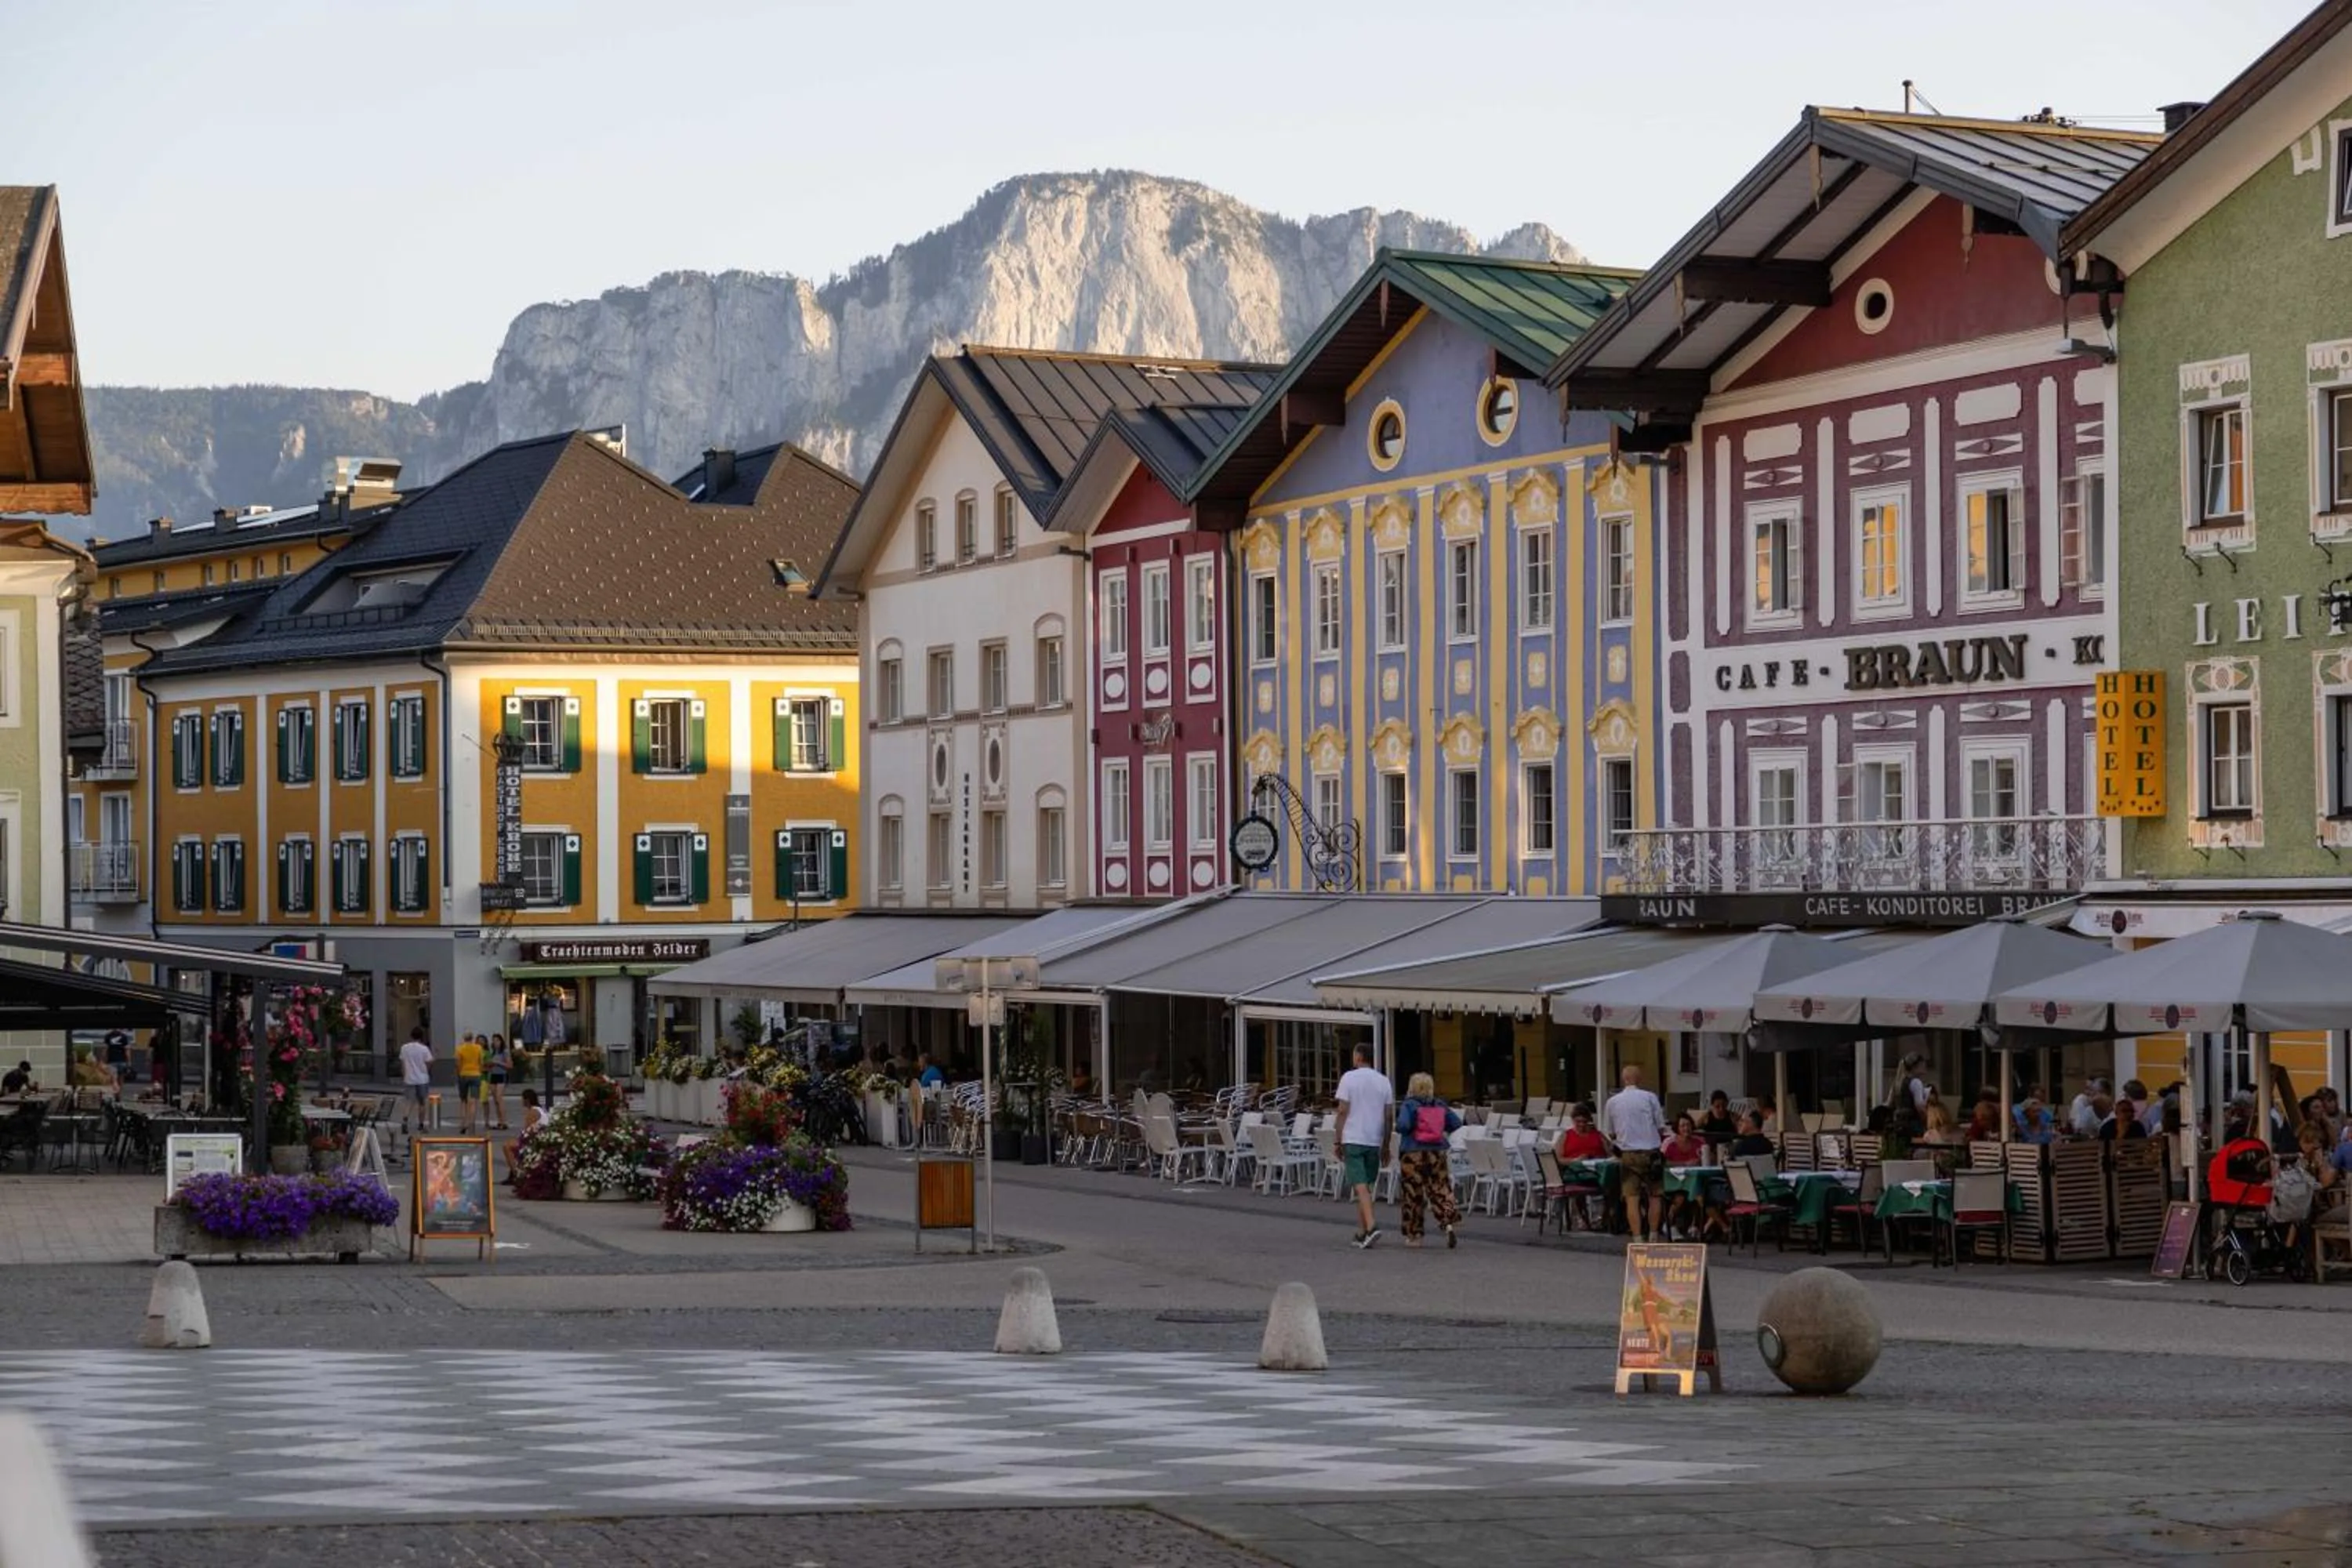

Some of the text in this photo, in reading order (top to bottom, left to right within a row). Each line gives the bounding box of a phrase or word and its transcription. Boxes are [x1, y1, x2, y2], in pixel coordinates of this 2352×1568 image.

[1715, 659, 1809, 691] CAFE
[1843, 633, 2028, 691] BRAUN
[2103, 675, 2119, 796] HOTEL
[2133, 675, 2157, 796] HOTEL
[506, 765, 521, 873] HOTEL KRONE
[2002, 896, 2068, 916] BRA
[540, 944, 644, 959] Trachtenmoden
